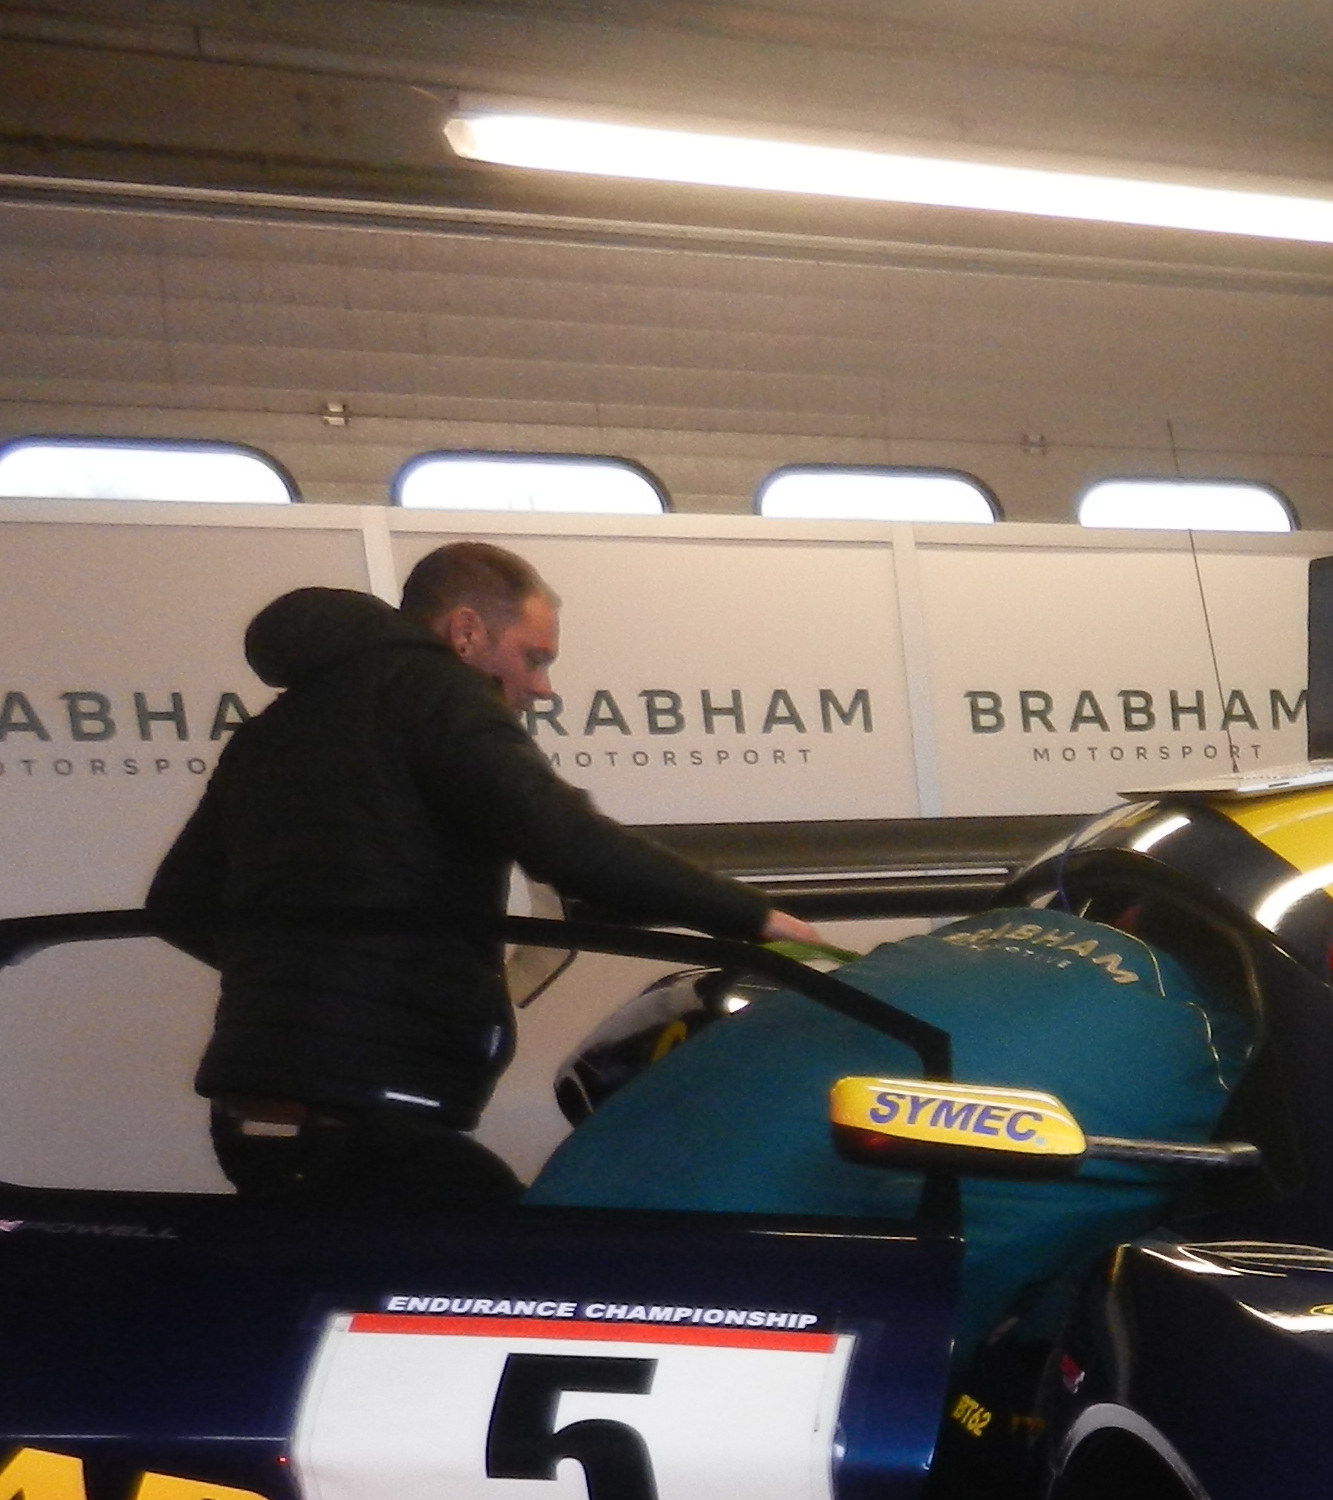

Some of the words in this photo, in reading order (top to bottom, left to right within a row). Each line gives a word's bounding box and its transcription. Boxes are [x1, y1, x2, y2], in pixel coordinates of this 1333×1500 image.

[964, 689, 1308, 734] BRABHAM
[1034, 744, 1262, 762] MOTORSPORT
[388, 1296, 578, 1318] ENDURANCE
[584, 1302, 819, 1330] CHAMPIONSHIP
